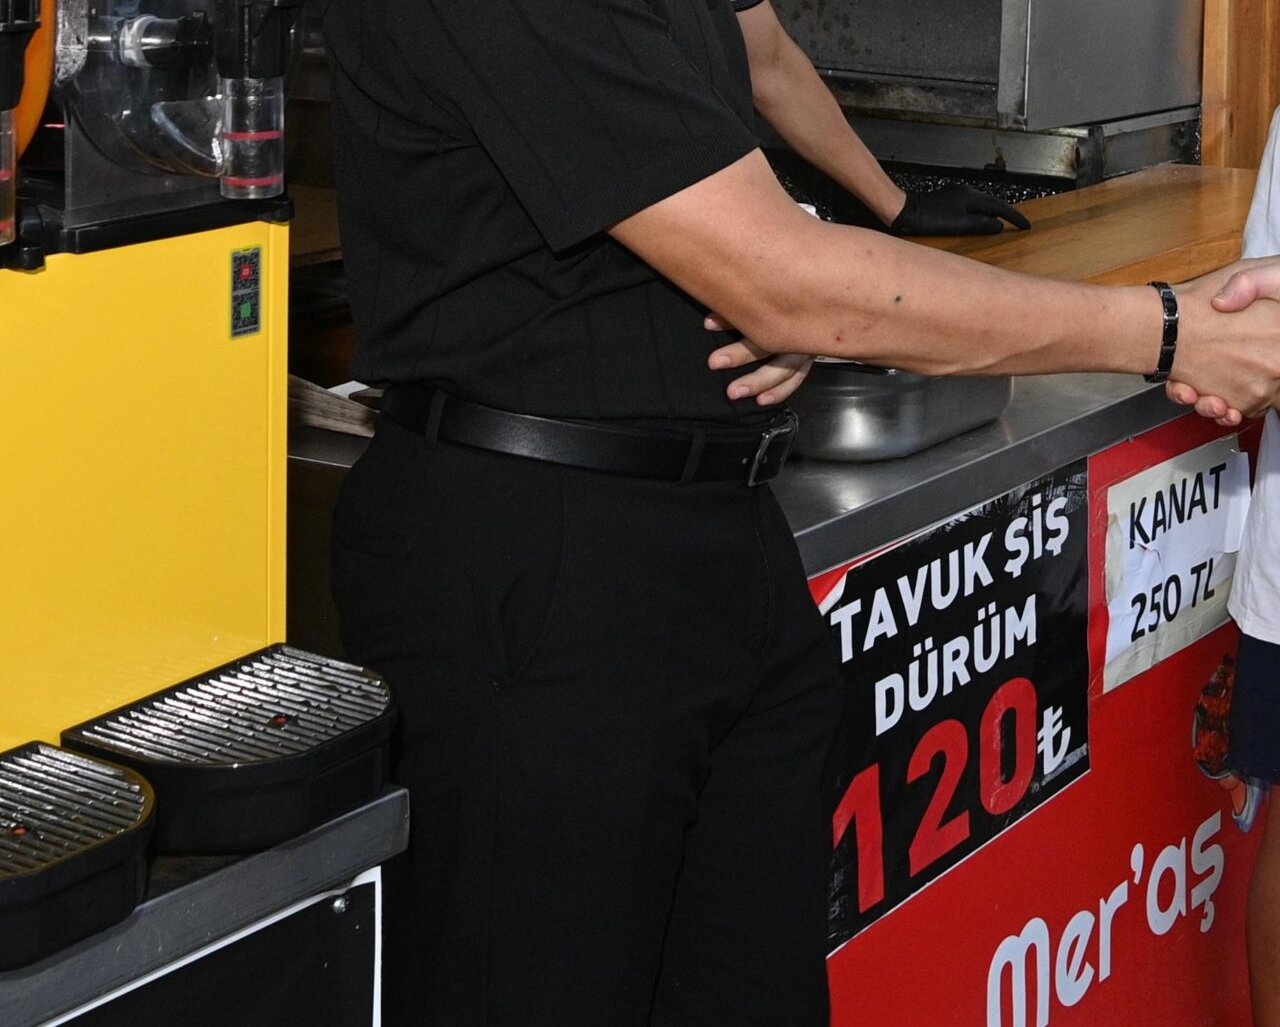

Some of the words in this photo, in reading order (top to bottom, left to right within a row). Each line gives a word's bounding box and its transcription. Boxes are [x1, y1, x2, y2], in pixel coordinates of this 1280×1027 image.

[1129, 462, 1227, 550] KANAT
[830, 531, 995, 664] TAVUK
[1004, 492, 1070, 579] ŞİŞ
[1130, 574, 1182, 643] 250
[1190, 557, 1215, 609] TL
[875, 593, 1037, 737] DÜRÜM
